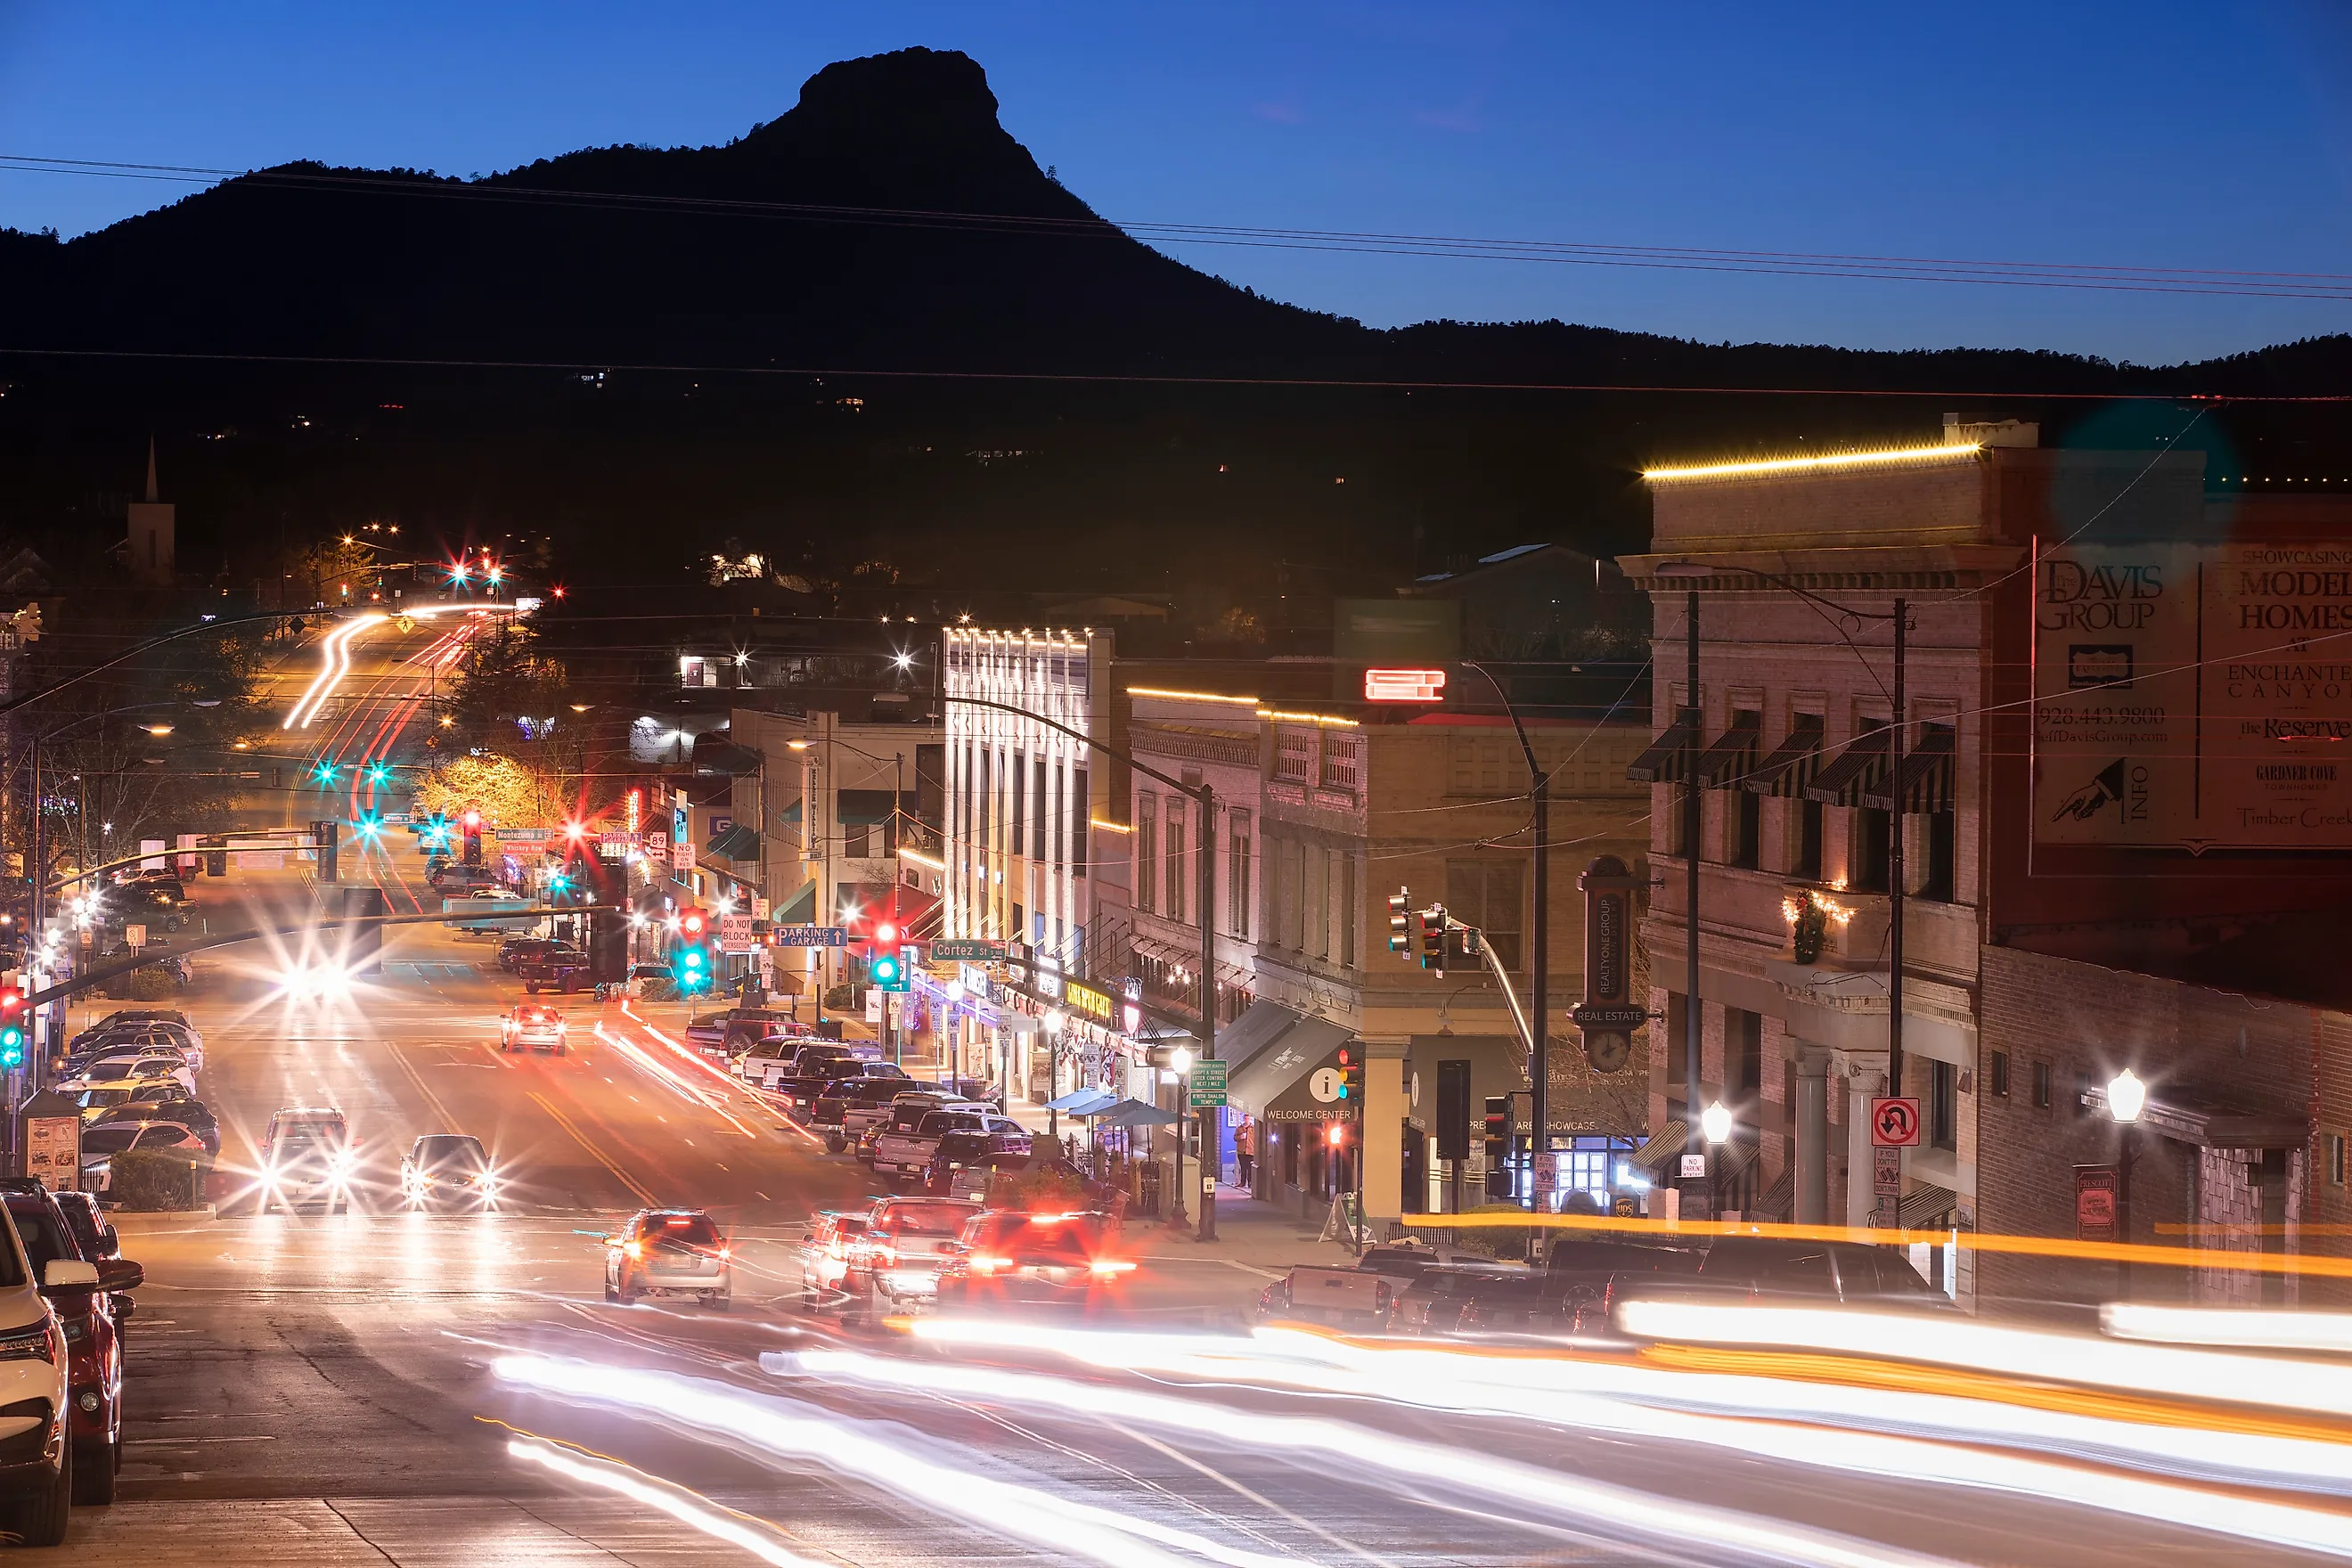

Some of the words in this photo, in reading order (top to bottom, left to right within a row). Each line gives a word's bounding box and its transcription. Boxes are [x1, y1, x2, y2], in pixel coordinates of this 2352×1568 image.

[2242, 551, 2352, 564] SHOWCASING
[2045, 559, 2164, 604] DAVIS
[2240, 571, 2352, 596] MODEL
[2036, 588, 2155, 633] GROUP
[2239, 604, 2352, 630] HOMES
[2286, 637, 2310, 651] AT
[2228, 683, 2352, 698] CANYO
[2039, 707, 2165, 725] 928.443.9800
[2242, 722, 2261, 734] the
[2264, 718, 2351, 743] Reserve
[2256, 765, 2307, 780] GARDNER
[2310, 765, 2337, 781] COVE
[2132, 766, 2148, 821] INFO
[2237, 807, 2296, 827] Timber
[2301, 806, 2352, 828] Creek
[652, 837, 664, 845] 89
[724, 920, 734, 928] DO
[737, 920, 750, 928] NOT
[723, 932, 750, 940] BLOCK
[778, 928, 829, 946] PARKING
[791, 937, 829, 945] GARAGE
[937, 944, 973, 956] Cortez
[1578, 1012, 1602, 1021] REAL
[1605, 1011, 1642, 1021] ESTATE
[1267, 1110, 1313, 1120] WELCOME
[1315, 1111, 1351, 1119] CENTER
[2080, 1179, 2111, 1187] PRESCOTT
